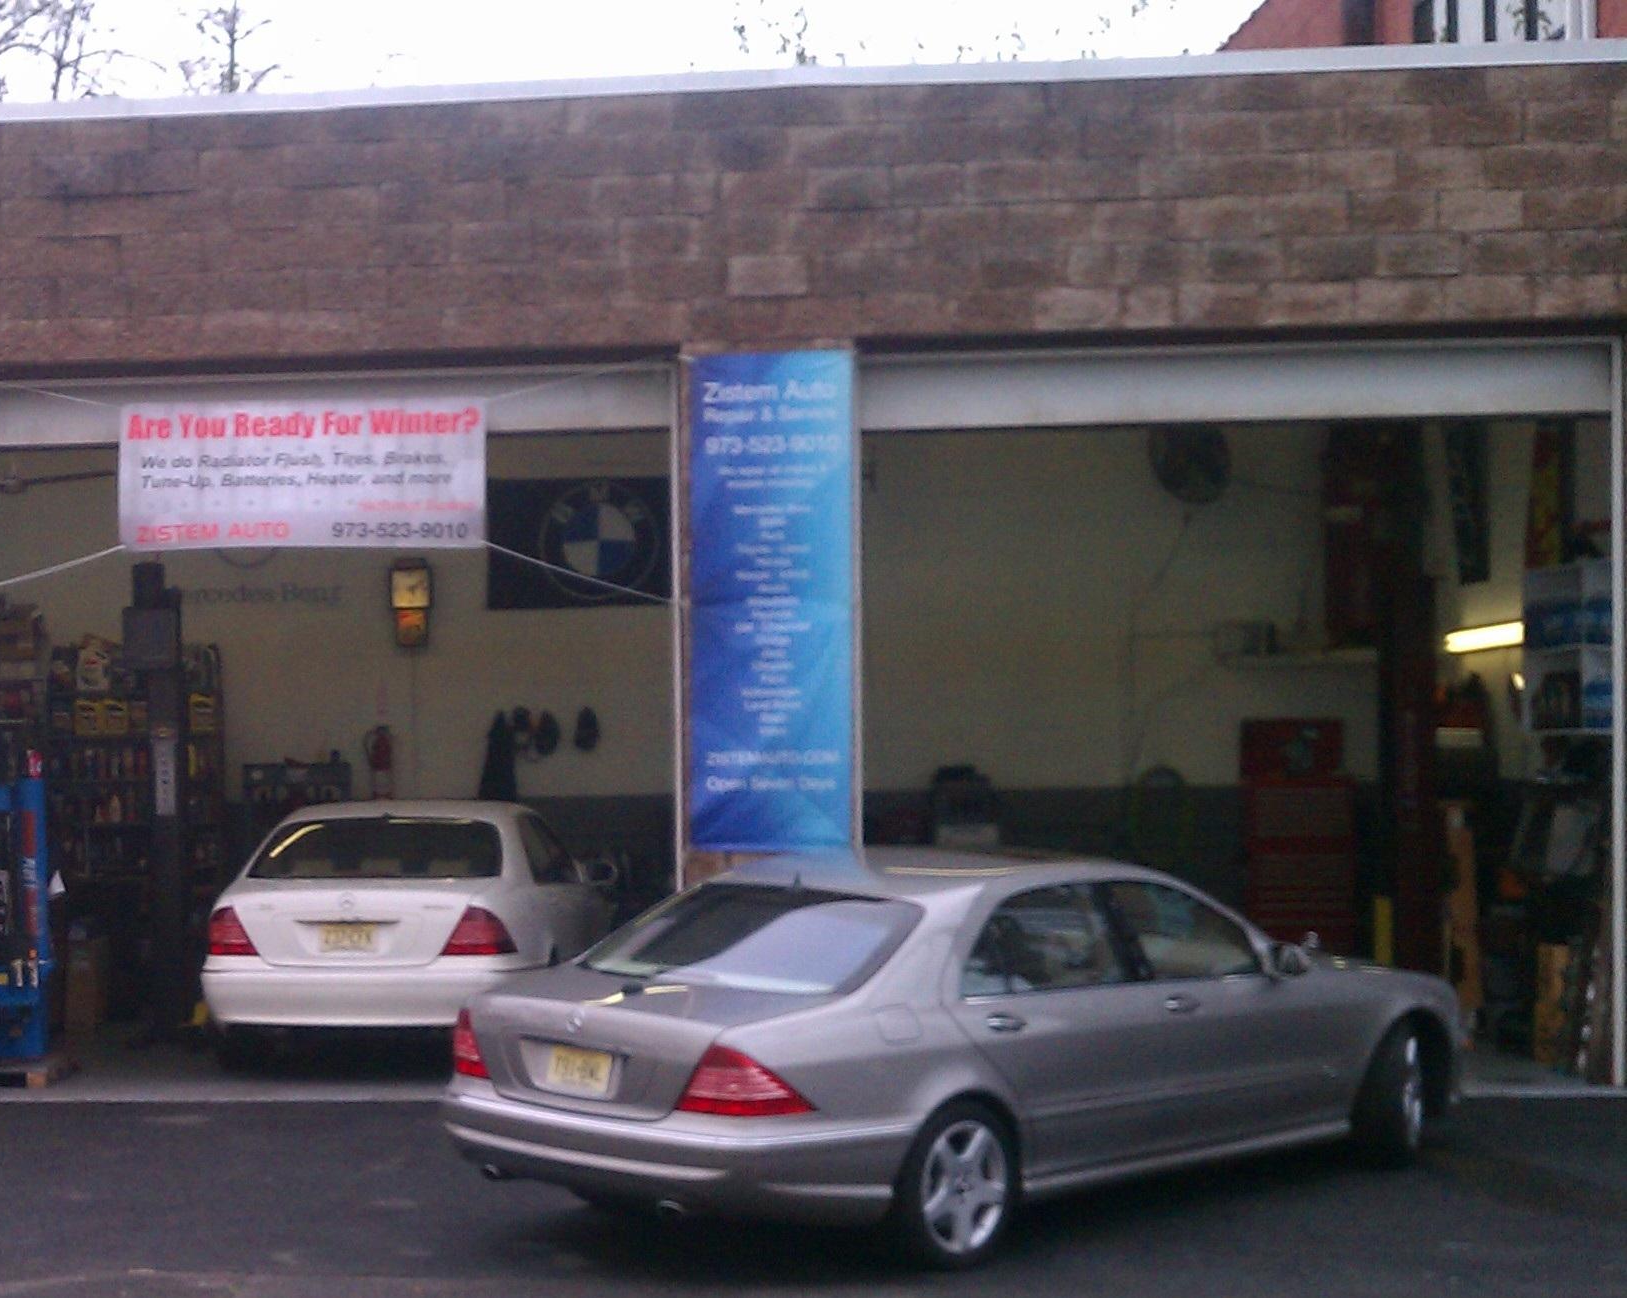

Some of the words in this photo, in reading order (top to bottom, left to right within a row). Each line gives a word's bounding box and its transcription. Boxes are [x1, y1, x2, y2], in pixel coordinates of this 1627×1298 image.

[128, 413, 171, 440] Are
[178, 412, 225, 439] You
[233, 411, 315, 439] Ready
[323, 411, 363, 437] For
[368, 407, 481, 435] Winter?
[141, 455, 168, 469] We
[172, 455, 194, 468] do
[197, 453, 271, 468] Radiator
[372, 471, 405, 486] and
[407, 473, 451, 485] more
[136, 524, 219, 544] ZISTEM
[228, 521, 291, 540] AUTO
[332, 521, 469, 540] 973-523-9010
